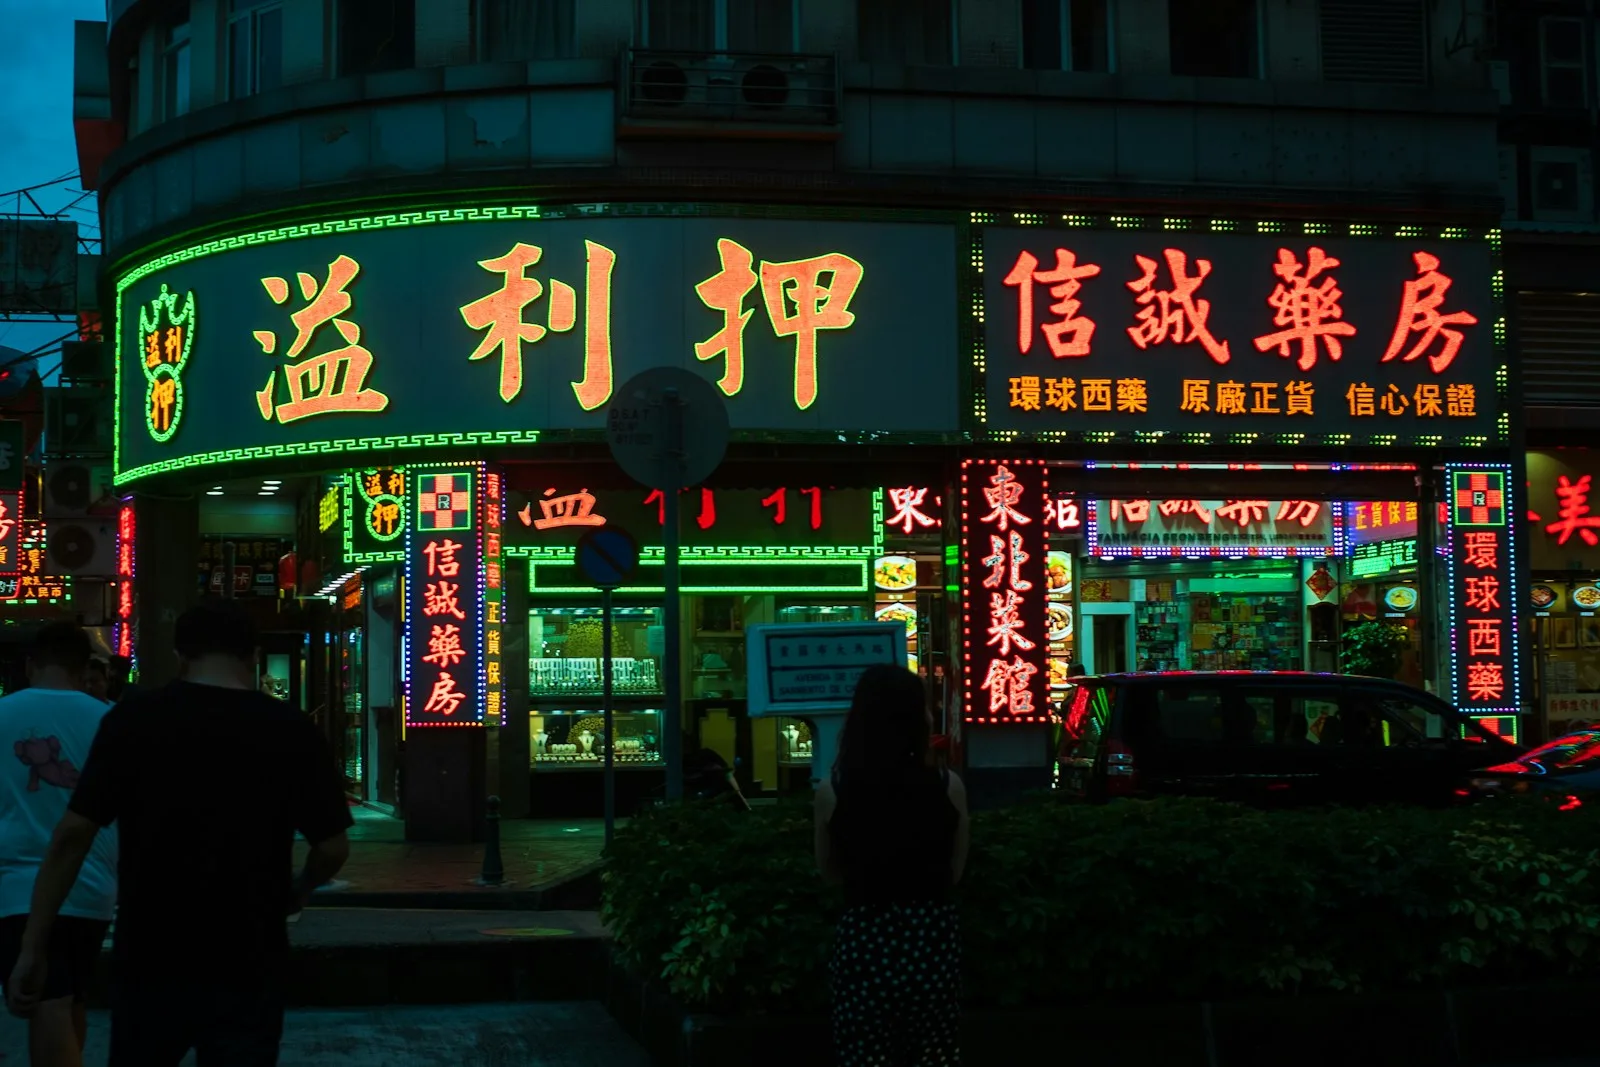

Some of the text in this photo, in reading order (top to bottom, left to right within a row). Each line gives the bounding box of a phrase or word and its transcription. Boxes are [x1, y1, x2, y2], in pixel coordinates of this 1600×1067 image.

[146, 326, 183, 368] 溢利
[253, 238, 864, 424] 溢利押
[1003, 247, 1478, 374] 信誠藥房
[151, 378, 176, 431] 押
[1009, 377, 1477, 418] 環球西藥 原廠正貨 信心保證
[365, 473, 405, 496] 溢利
[372, 502, 398, 534] 押
[1527, 475, 1600, 545] 美
[421, 539, 467, 716] 信誠藥房
[980, 465, 1038, 714] 東北菜館
[1463, 531, 1505, 701] 環球西藥
[487, 602, 500, 715] 正貨保證
